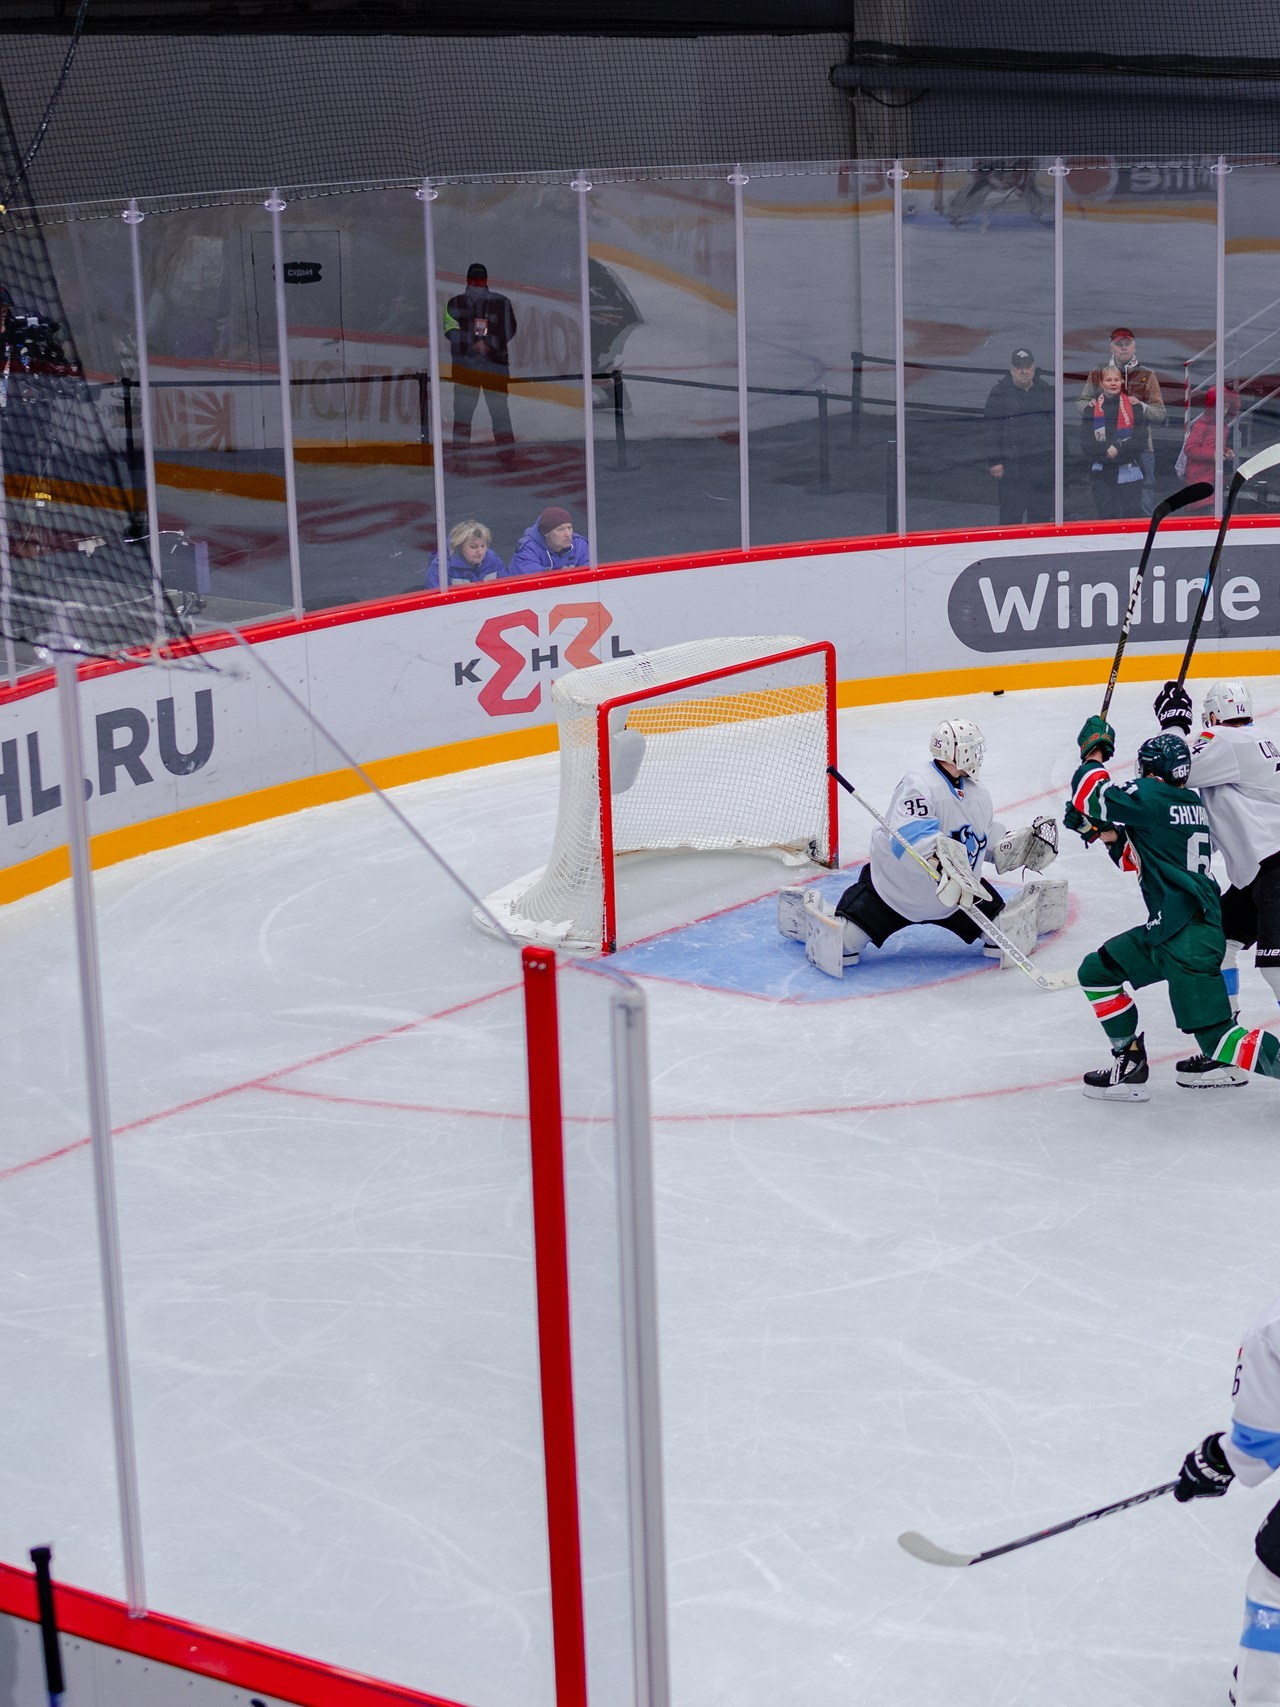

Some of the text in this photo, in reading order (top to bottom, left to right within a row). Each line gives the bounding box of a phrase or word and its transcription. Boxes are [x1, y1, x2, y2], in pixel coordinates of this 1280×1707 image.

[977, 565, 1262, 633] Winline
[1236, 703, 1246, 714] 14
[933, 738, 943, 749] 35
[904, 798, 929, 817] 35
[1232, 1365, 1242, 1396] 6
